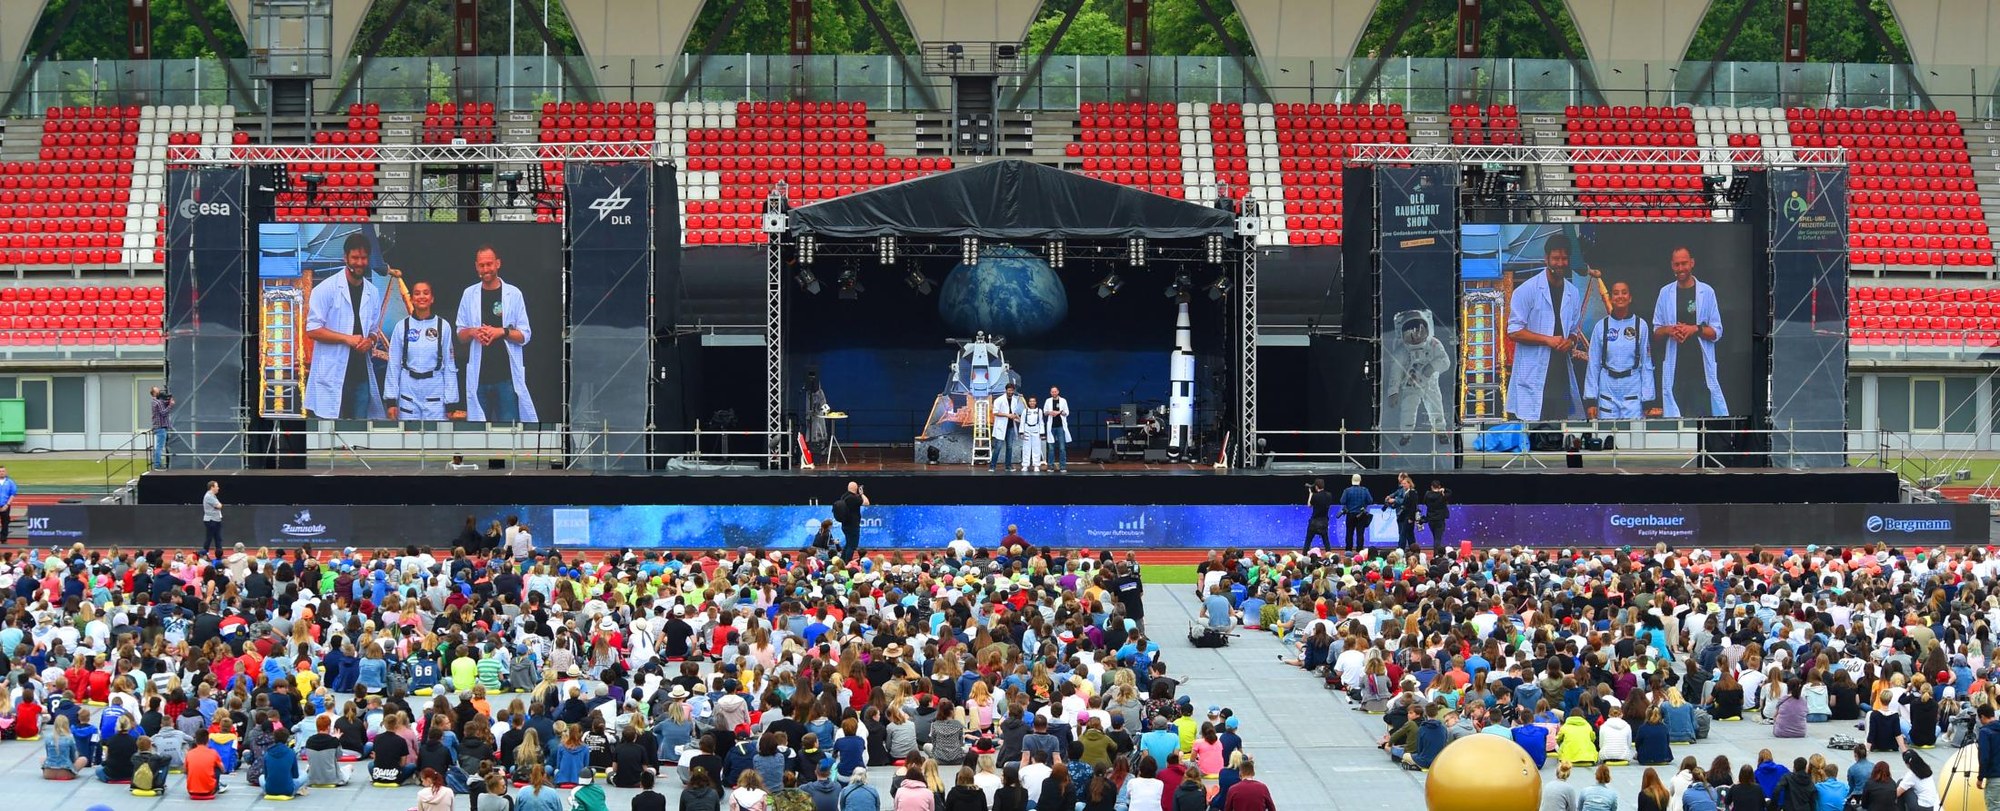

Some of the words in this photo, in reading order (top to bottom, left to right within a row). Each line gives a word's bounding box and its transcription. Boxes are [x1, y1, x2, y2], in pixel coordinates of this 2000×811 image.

[1410, 193, 1425, 204] DLR
[1395, 204, 1440, 216] RAUMFAHRT
[611, 215, 632, 225] DLR
[1406, 216, 1429, 228] SHOW
[1610, 514, 1684, 528] Gegenbauer
[1884, 518, 1951, 533] Bergmann
[1638, 529, 1658, 537] Facility
